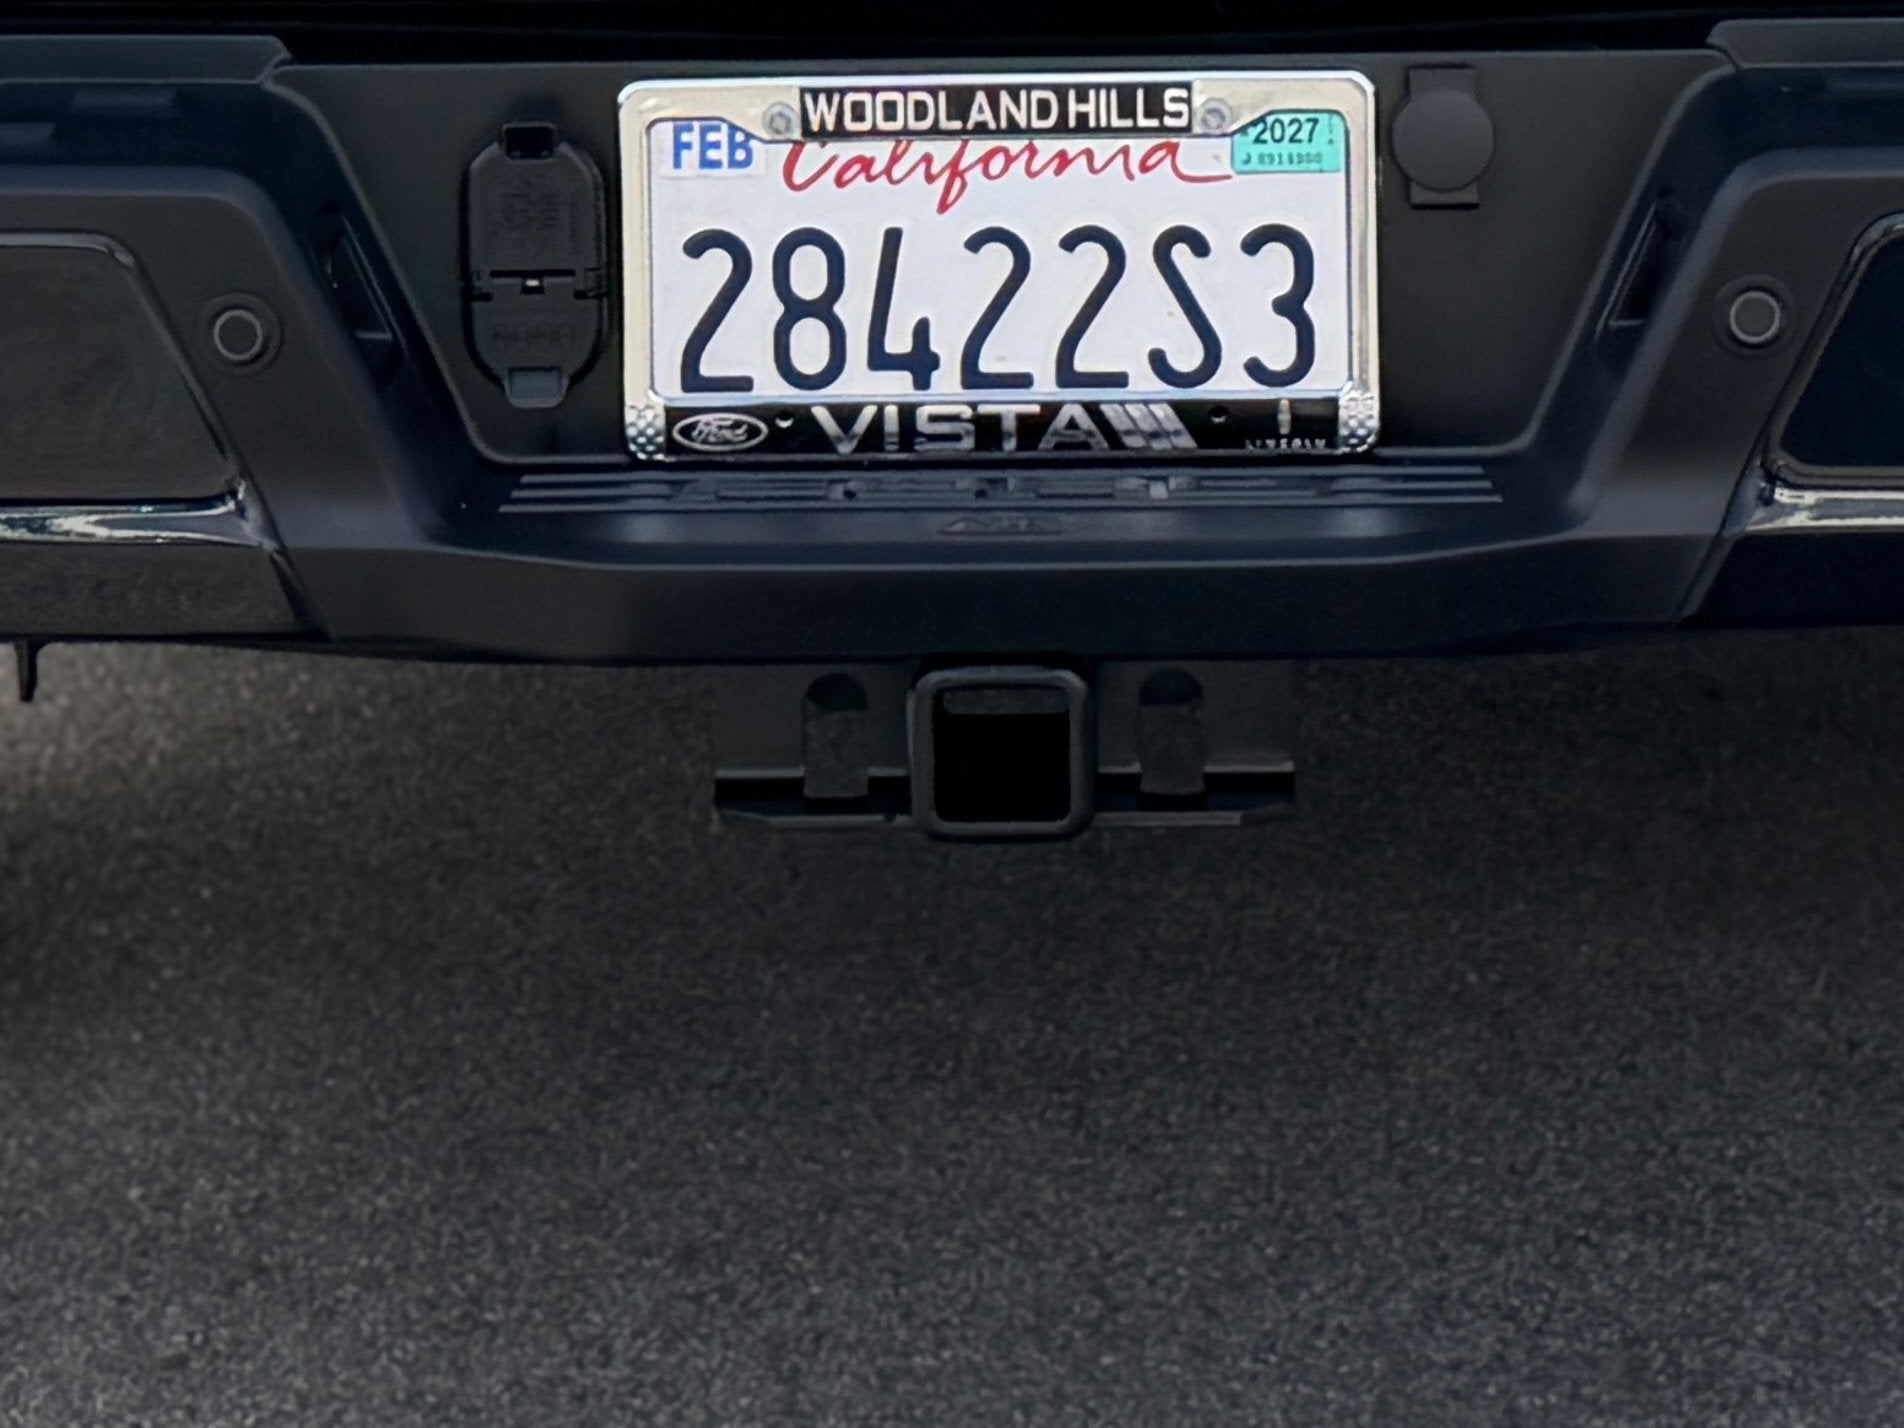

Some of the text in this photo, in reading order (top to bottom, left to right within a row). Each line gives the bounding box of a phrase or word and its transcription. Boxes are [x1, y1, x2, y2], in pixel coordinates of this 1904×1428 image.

[804, 87, 1189, 133] WOODLAND HILLS
[1253, 117, 1320, 144] 2027
[672, 121, 754, 170] FEB
[782, 139, 1233, 215] California
[681, 224, 1316, 394] 28422S3
[810, 403, 1111, 454] VISTA
